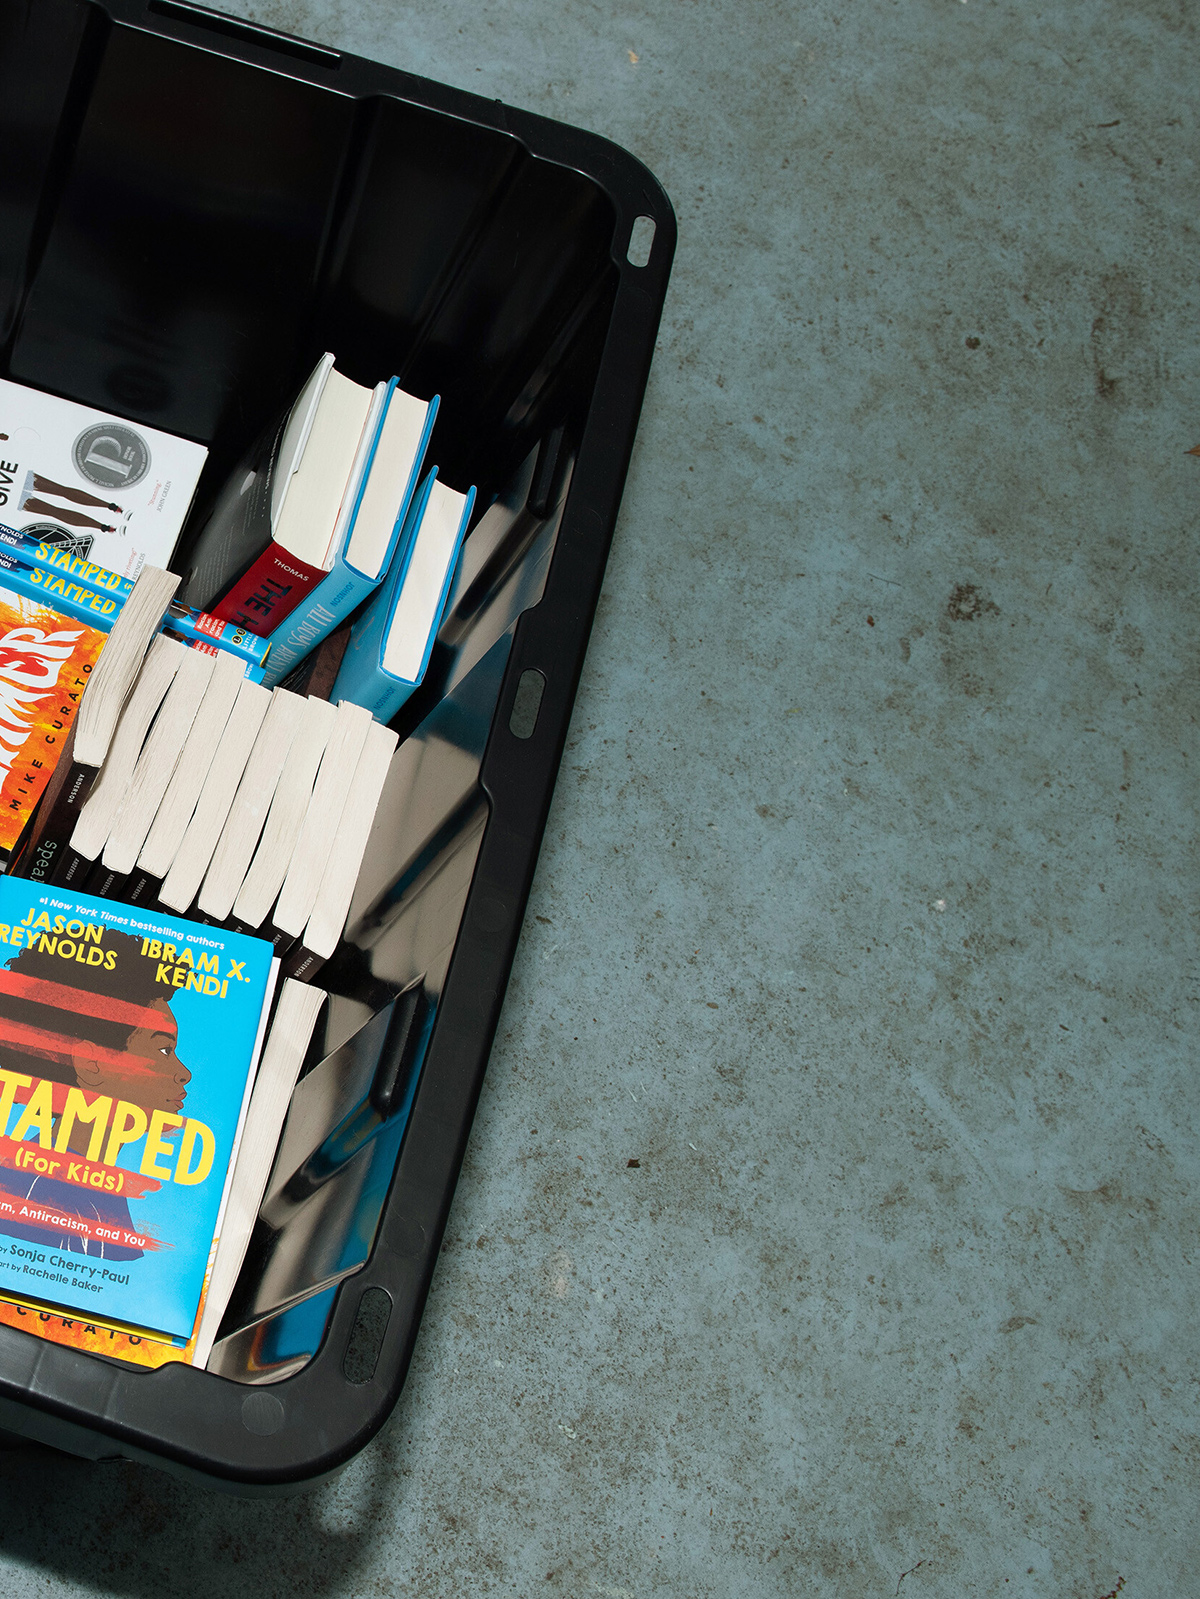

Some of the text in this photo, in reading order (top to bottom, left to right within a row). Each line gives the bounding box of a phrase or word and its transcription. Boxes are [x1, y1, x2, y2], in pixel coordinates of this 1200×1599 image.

[162, 480, 172, 498] GREEN
[35, 542, 121, 591] STAMPED
[273, 557, 310, 582] THOMAS
[29, 567, 116, 615] STAMPED
[244, 577, 293, 617] THE
[330, 581, 355, 607] JOHNSON
[306, 603, 336, 627] ALL
[287, 620, 321, 649] BOYS
[374, 686, 396, 710] JOHNSON
[9, 663, 93, 811] MIKE CURATO
[67, 773, 85, 804] ANDERSON
[65, 857, 80, 881] ANDERSON
[99, 874, 115, 896] ANDERSON
[131, 878, 147, 900] ANDERSON
[20, 907, 105, 945] JASON
[49, 898, 72, 911] New
[75, 904, 99, 918] York
[100, 910, 129, 926] Times
[129, 917, 184, 942] bestselling
[186, 933, 225, 950] authors
[140, 938, 251, 983] IBRAM X.
[293, 956, 314, 977] ANDERSON
[155, 963, 229, 998] KENDI
[14, 1147, 125, 1193] (For Kids)
[19, 1204, 92, 1234] Antiracism,
[95, 1223, 121, 1240] and
[122, 1229, 146, 1247] You
[9, 1244, 46, 1265] Sonja
[49, 1255, 130, 1285] Cherry-Paul
[11, 1263, 22, 1273] by
[22, 1264, 69, 1285] Rachelle
[71, 1277, 104, 1294] Baker
